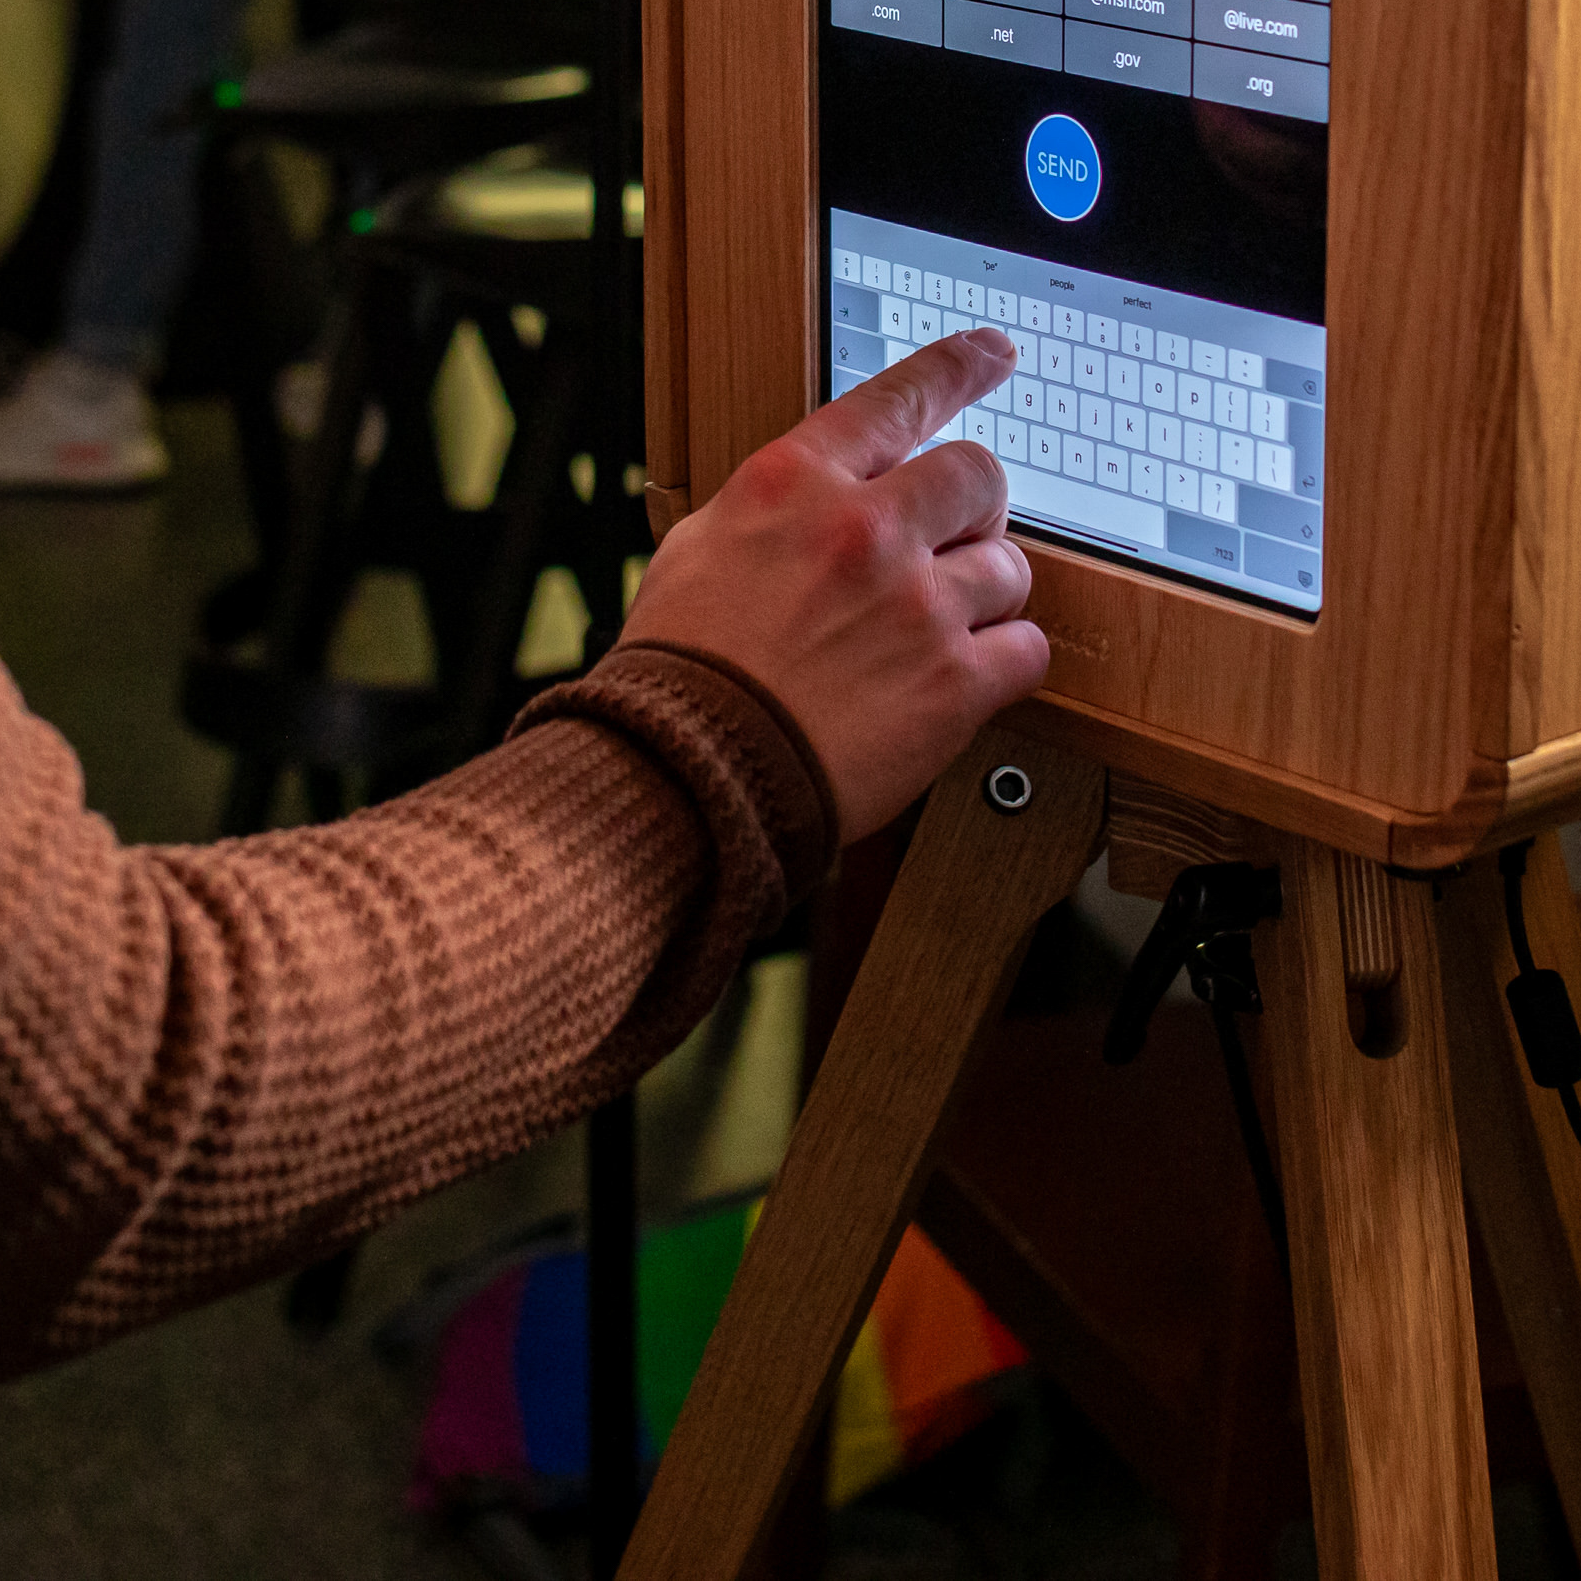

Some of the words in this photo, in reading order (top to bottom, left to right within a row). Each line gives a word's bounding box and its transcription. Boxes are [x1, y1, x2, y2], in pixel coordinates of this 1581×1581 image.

[871, 5, 900, 22] .com
[1223, 9, 1298, 39] @live.com
[990, 28, 1014, 44] .net
[1112, 51, 1142, 69] .gov
[1246, 76, 1274, 97] .org
[1037, 151, 1089, 182] SEND
[1049, 278, 1075, 292] people
[1123, 296, 1152, 311] perfect
[905, 283, 910, 293] 2
[936, 291, 941, 301] 3
[967, 300, 973, 308] 4
[999, 307, 1005, 317] 5
[1032, 316, 1038, 326] 6
[1066, 324, 1072, 334] 7
[1100, 334, 1106, 344] 8
[1134, 342, 1141, 353] 9
[892, 312, 899, 326] q
[1020, 345, 1025, 357] t
[1051, 355, 1059, 369] y
[1085, 363, 1093, 376] u
[1154, 382, 1163, 394] o
[1190, 391, 1199, 406] p
[1025, 393, 1033, 407] g
[1058, 398, 1066, 414] h
[1093, 409, 1098, 426] j
[1126, 417, 1134, 433] k
[976, 424, 984, 435] c
[1008, 433, 1016, 444] v
[1041, 439, 1049, 454] b
[1075, 452, 1082, 464] n
[1107, 461, 1118, 474] m
